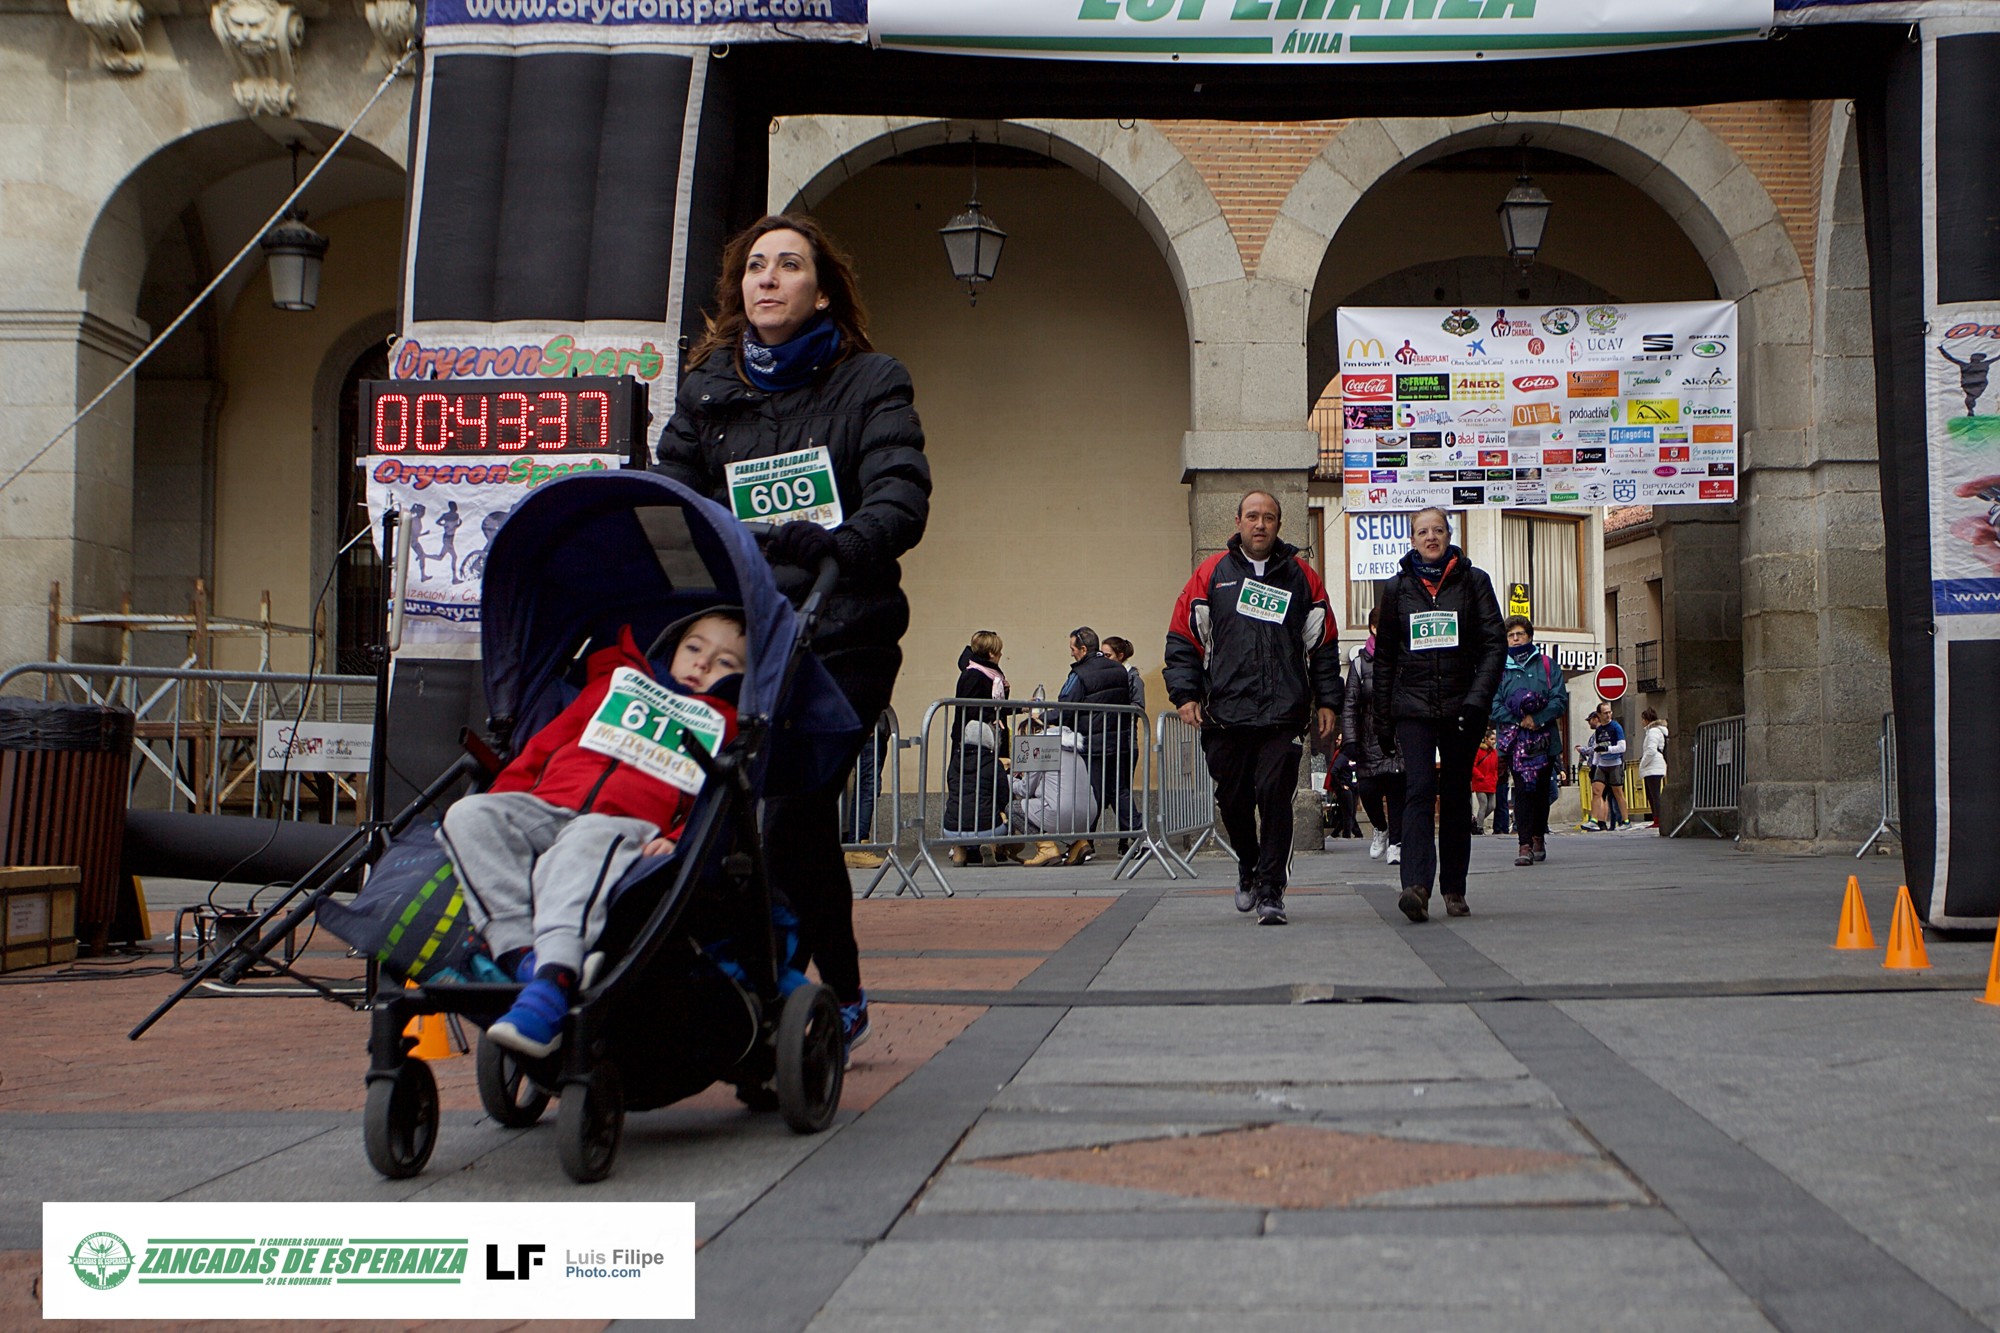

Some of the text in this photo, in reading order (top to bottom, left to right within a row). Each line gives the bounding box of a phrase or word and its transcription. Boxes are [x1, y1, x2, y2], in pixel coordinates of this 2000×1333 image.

[1281, 28, 1344, 54] ÁVILA
[1511, 328, 1534, 336] CHANDAL
[1587, 338, 1624, 351] UCAV
[1632, 354, 1684, 362] SEAT
[1409, 376, 1438, 385] FRUTAS
[1457, 378, 1500, 389] ANETO
[1519, 376, 1555, 389] Lotus
[375, 391, 608, 451] 00:43:37
[1569, 405, 1609, 424] podoactiva
[1458, 431, 1475, 444] abad
[1485, 433, 1506, 444] Ávila
[1620, 429, 1651, 440] diegodiez
[735, 451, 820, 476] CARRERA SOLIDARIA
[750, 477, 816, 514] 609
[1392, 488, 1450, 496] Ayuntamiento
[1373, 542, 1411, 555] EN LA TIE
[1357, 562, 1395, 575] C/ REYES
[1249, 593, 1280, 611] 615
[1419, 622, 1449, 637] 617
[1558, 645, 1602, 670] hogar
[623, 673, 669, 702] CARRERA
